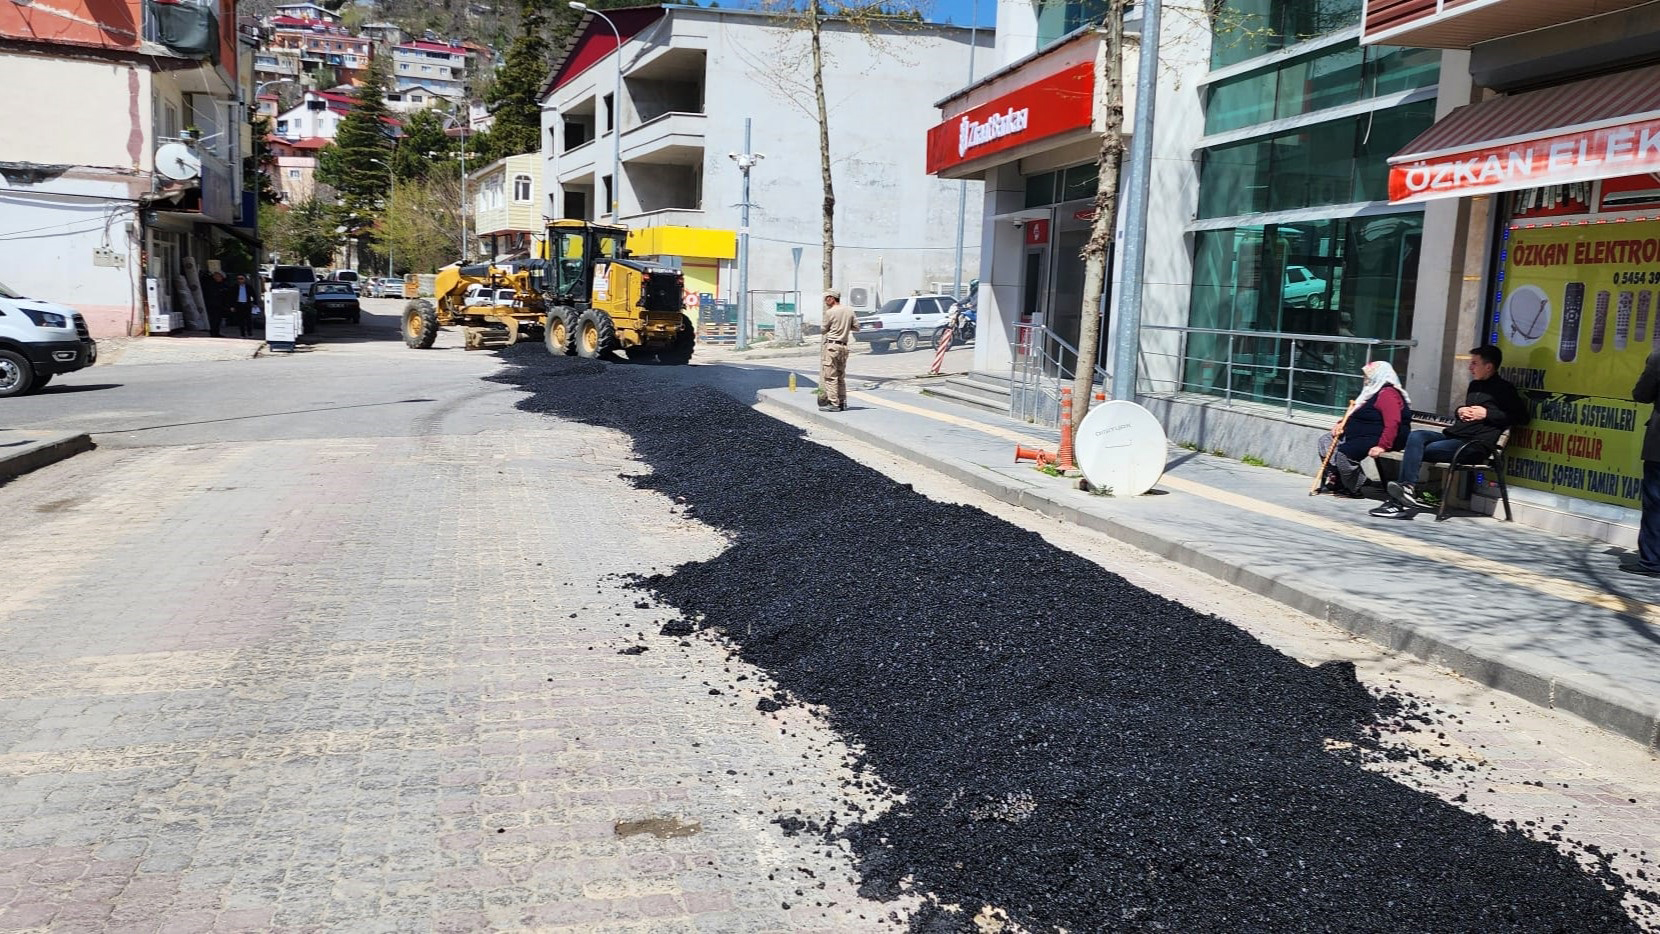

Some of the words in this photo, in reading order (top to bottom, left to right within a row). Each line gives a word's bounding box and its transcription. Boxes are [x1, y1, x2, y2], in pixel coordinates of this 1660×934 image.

[1405, 148, 1534, 192] ÖZKAN
[1547, 128, 1660, 172] ELEK
[1512, 240, 1569, 268] ÖZKAN
[1573, 238, 1660, 265] ELEKTRO
[1613, 272, 1620, 285] 0
[1621, 271, 1646, 284] 5454
[1535, 430, 1565, 455] PLANI
